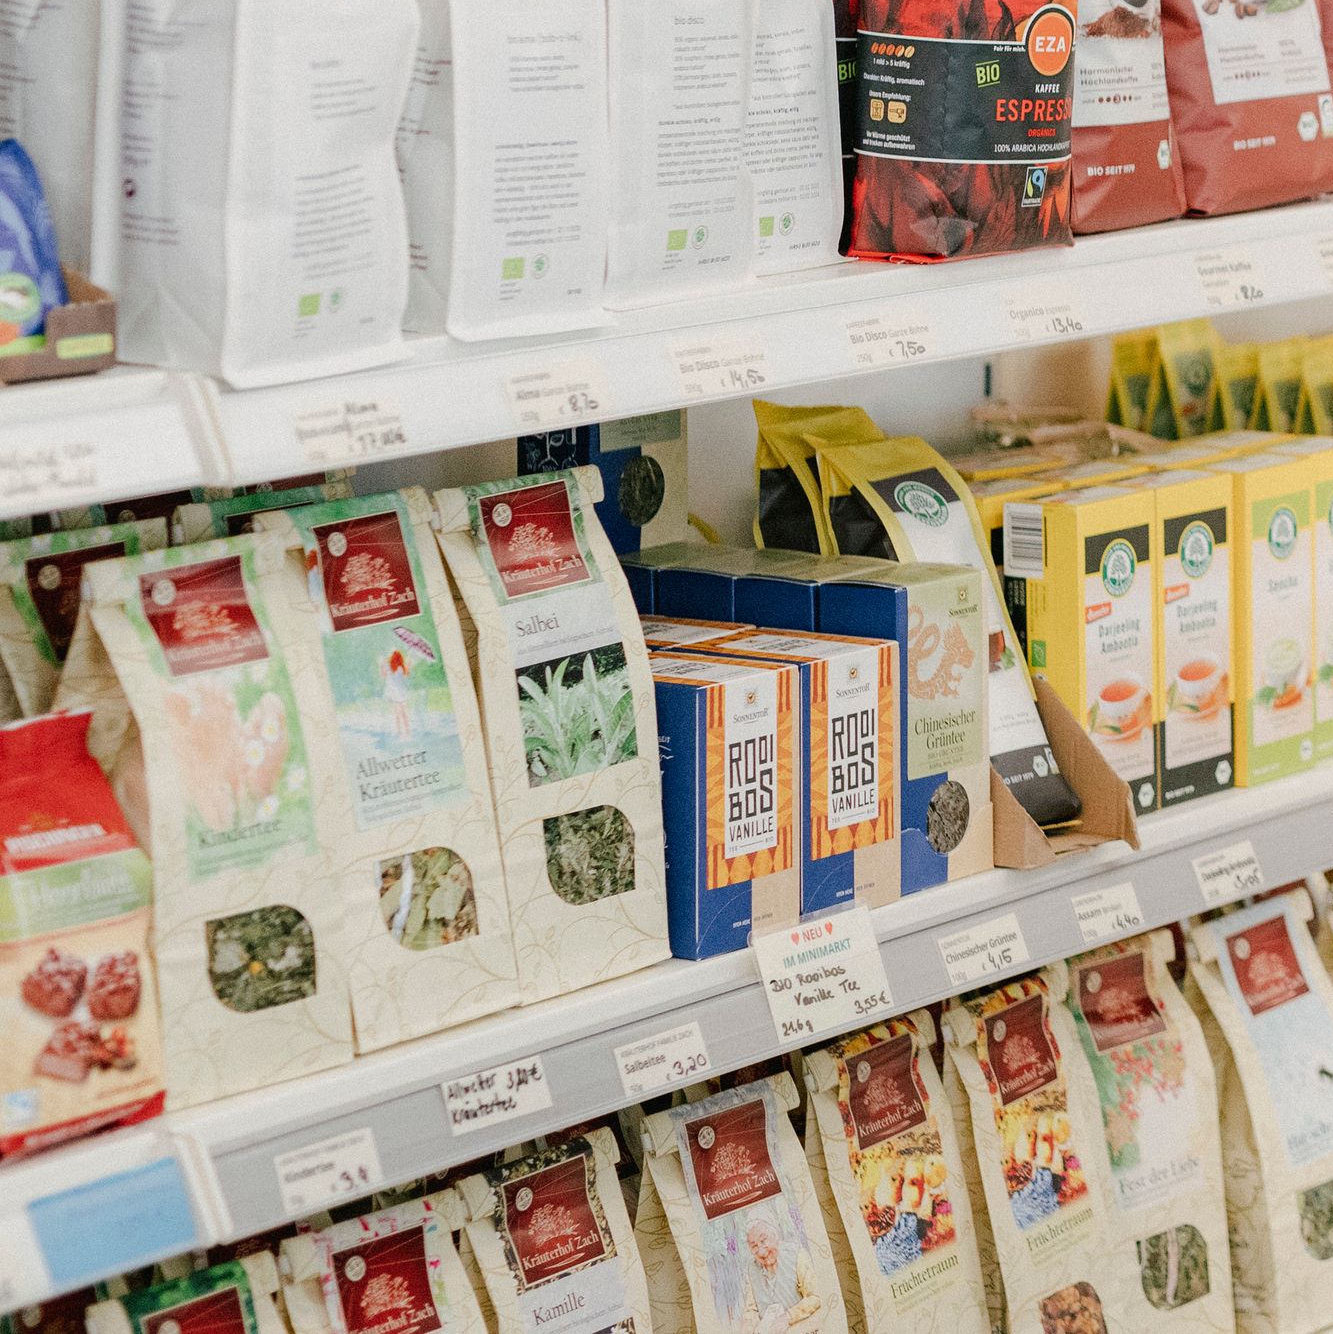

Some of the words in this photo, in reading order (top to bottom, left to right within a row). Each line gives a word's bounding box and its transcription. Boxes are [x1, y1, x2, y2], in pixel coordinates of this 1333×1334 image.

[1034, 36, 1067, 53] EZA
[896, 77, 925, 87] aromatisch
[976, 63, 1000, 84] BIO
[1035, 83, 1060, 94] KAFFEE
[994, 143, 1010, 153] 100%
[1012, 143, 1036, 153] ARABICA
[1086, 166, 1104, 178] BIO
[1009, 307, 1045, 321] Organico
[850, 333, 864, 345] Bio
[865, 329, 888, 342] Disco
[1051, 317, 1083, 335] 13,40
[896, 340, 926, 360] 7,50
[503, 564, 555, 585] Kräuterhof
[555, 555, 583, 571] Zach
[388, 588, 415, 605] Zach
[1176, 599, 1219, 619] Darjeeling
[514, 612, 561, 639] Salbei
[1098, 617, 1141, 639] Darjeeling
[1179, 615, 1217, 635] Ambootia
[1101, 637, 1139, 656] Ambootia
[836, 682, 871, 699] SONNENTOR
[733, 707, 769, 724] SONNENTOR
[914, 708, 977, 737] Chinesischer
[831, 708, 875, 762] ROOI
[925, 729, 966, 750] Grüntee
[356, 749, 428, 781] Allwetter
[728, 734, 774, 789] ROOI
[831, 741, 875, 795] BOS
[360, 770, 442, 802] Kräutertee
[728, 768, 774, 824] BOS
[831, 787, 875, 815] VANILLE
[199, 819, 282, 850] Kindertee
[729, 816, 774, 843] VANILLE
[802, 927, 823, 943] NEU
[783, 956, 798, 970] IM
[797, 937, 851, 967] MINIMARKT
[945, 941, 989, 965] Chinesischer
[987, 930, 1018, 950] Grüntee
[798, 964, 846, 987] Rooibos
[793, 988, 836, 1007] Vanille
[838, 979, 862, 994] Tee
[624, 1053, 667, 1075] Salbeitee
[672, 1053, 708, 1078] 3,20
[858, 1112, 902, 1138] Kräuterhof
[899, 1100, 923, 1120] Zach
[703, 1181, 752, 1208] Kräuterhof
[751, 1169, 777, 1188] Zach
[522, 1239, 576, 1272] Kräuterhof
[572, 1229, 600, 1250] Zach
[406, 1304, 437, 1324] Zach
[531, 1291, 587, 1326] Kamille
